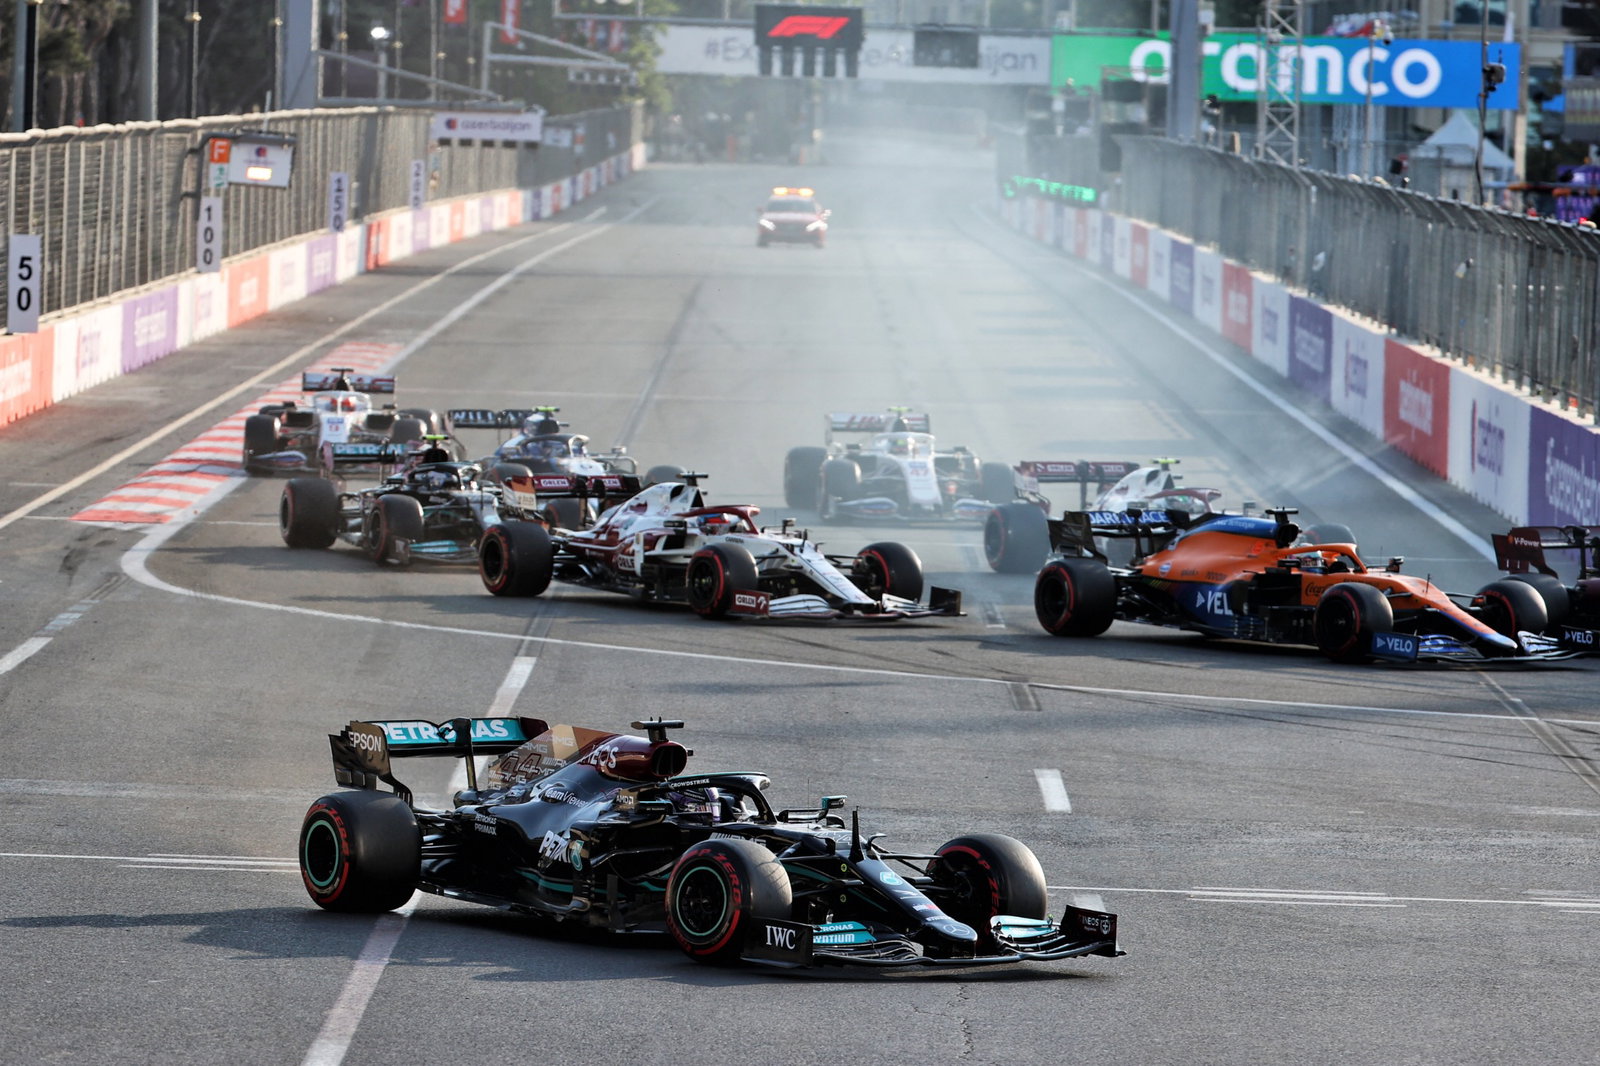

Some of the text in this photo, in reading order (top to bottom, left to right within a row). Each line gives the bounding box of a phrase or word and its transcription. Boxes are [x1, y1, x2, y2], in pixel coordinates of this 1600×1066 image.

[767, 15, 850, 39] F1
[203, 205, 214, 265] 100
[17, 256, 33, 311] 50
[1514, 537, 1540, 548] V-Power
[736, 594, 755, 605] ORLEN
[1207, 590, 1235, 616] VEL
[1387, 637, 1413, 653] VELO
[1571, 631, 1593, 645] VELO
[379, 719, 509, 741] PETROAS
[348, 732, 382, 752] EPSON
[670, 778, 710, 789] CROWDSTRIKE
[765, 925, 796, 949] IWC
[815, 924, 854, 932] RONAS
